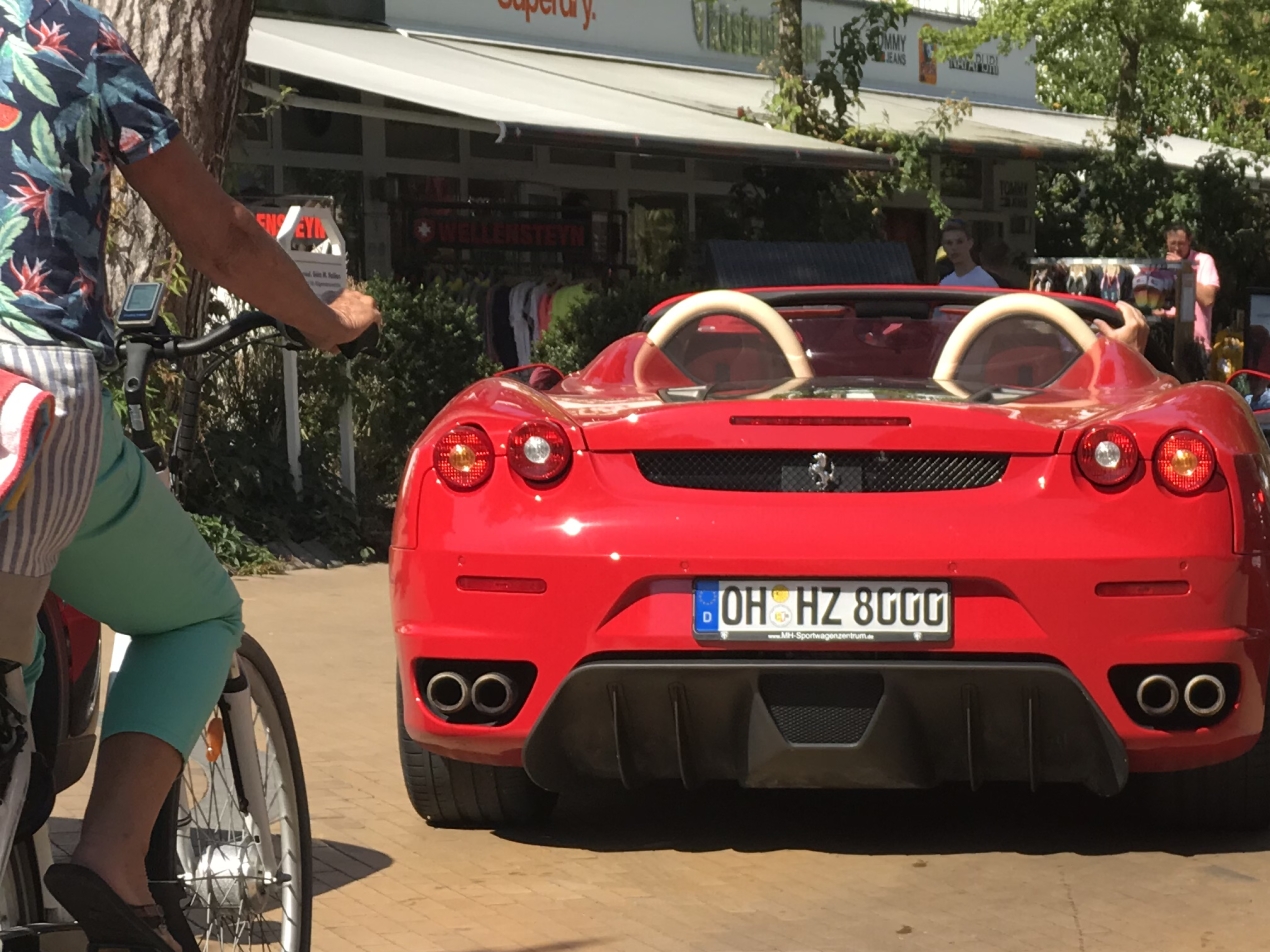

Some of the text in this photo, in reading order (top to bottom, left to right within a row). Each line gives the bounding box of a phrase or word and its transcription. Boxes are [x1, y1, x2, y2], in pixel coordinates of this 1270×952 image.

[875, 32, 907, 52] OMMY
[886, 52, 907, 66] JEANS
[438, 221, 585, 247] WELLENSTEYN
[721, 585, 944, 627] OH HZ 8000
[703, 611, 713, 623] D
[767, 631, 875, 641] www.MH-Sportwagenzentrum.de
